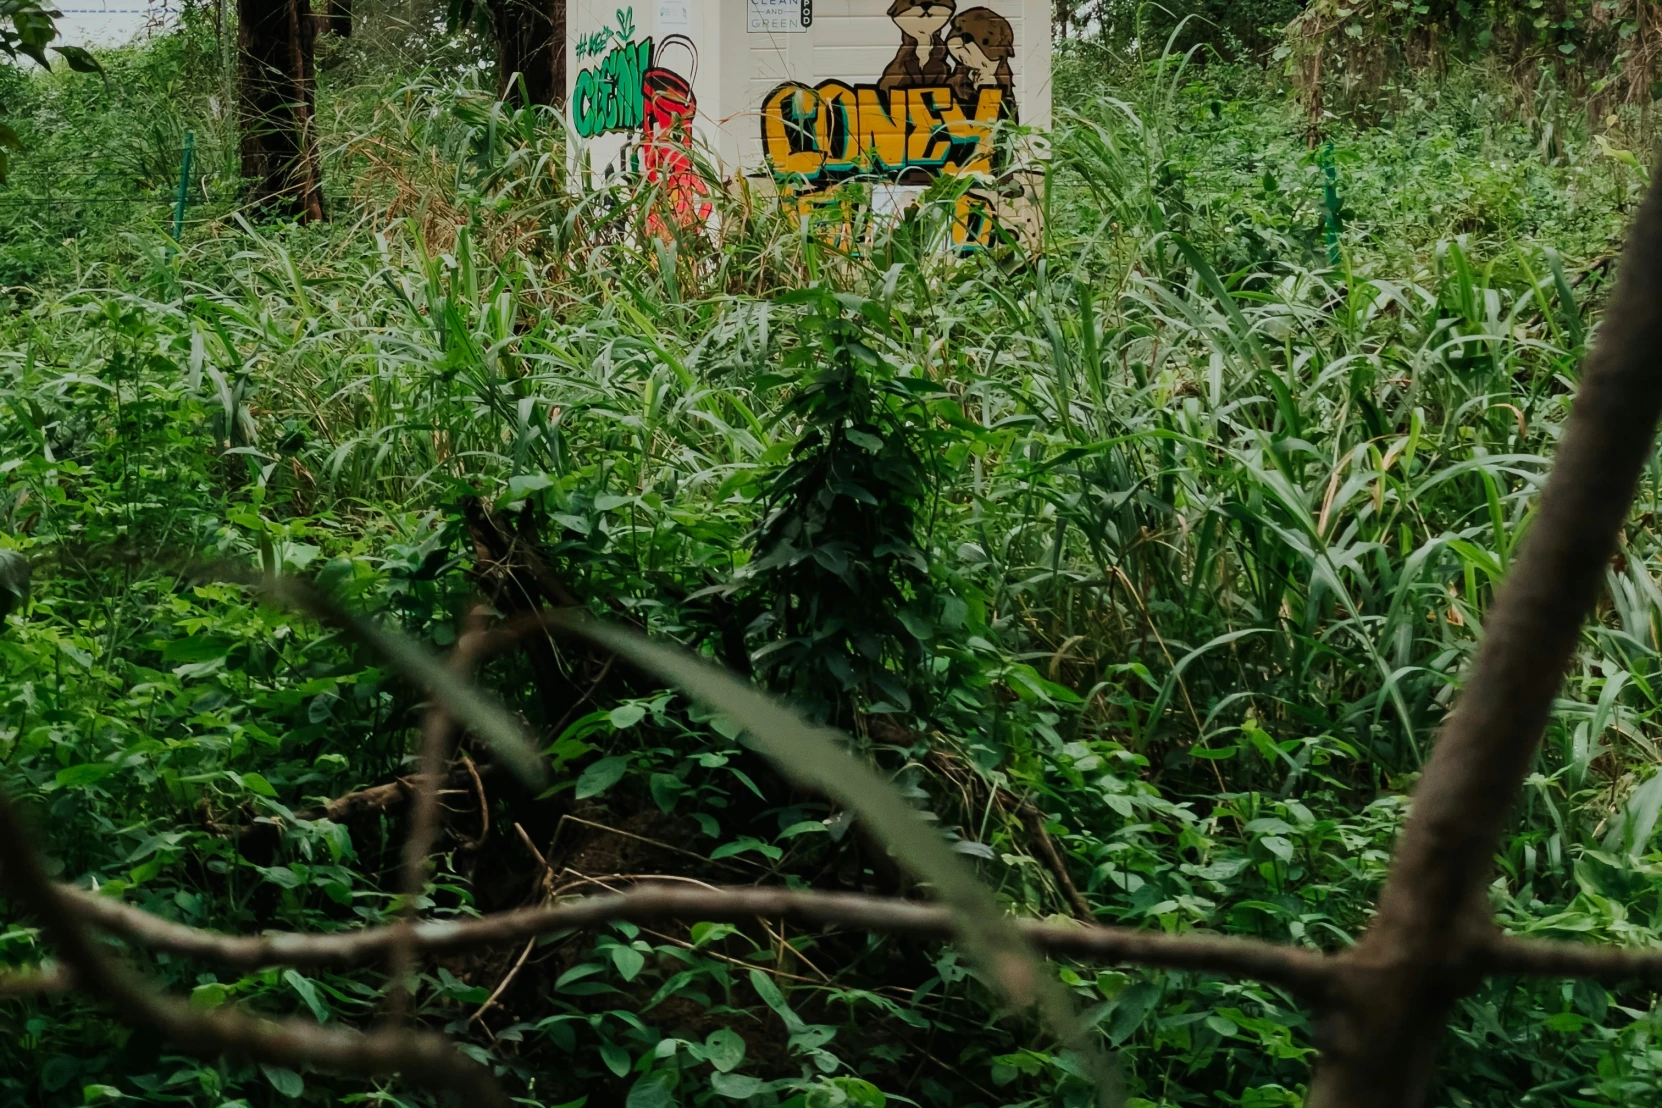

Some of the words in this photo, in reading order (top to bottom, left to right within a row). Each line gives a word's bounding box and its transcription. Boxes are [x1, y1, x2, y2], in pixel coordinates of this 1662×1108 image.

[751, 18, 798, 28] GREEN
[803, 0, 811, 25] POD
[573, 36, 654, 138] CLEAN
[761, 78, 1016, 182] CONEY
